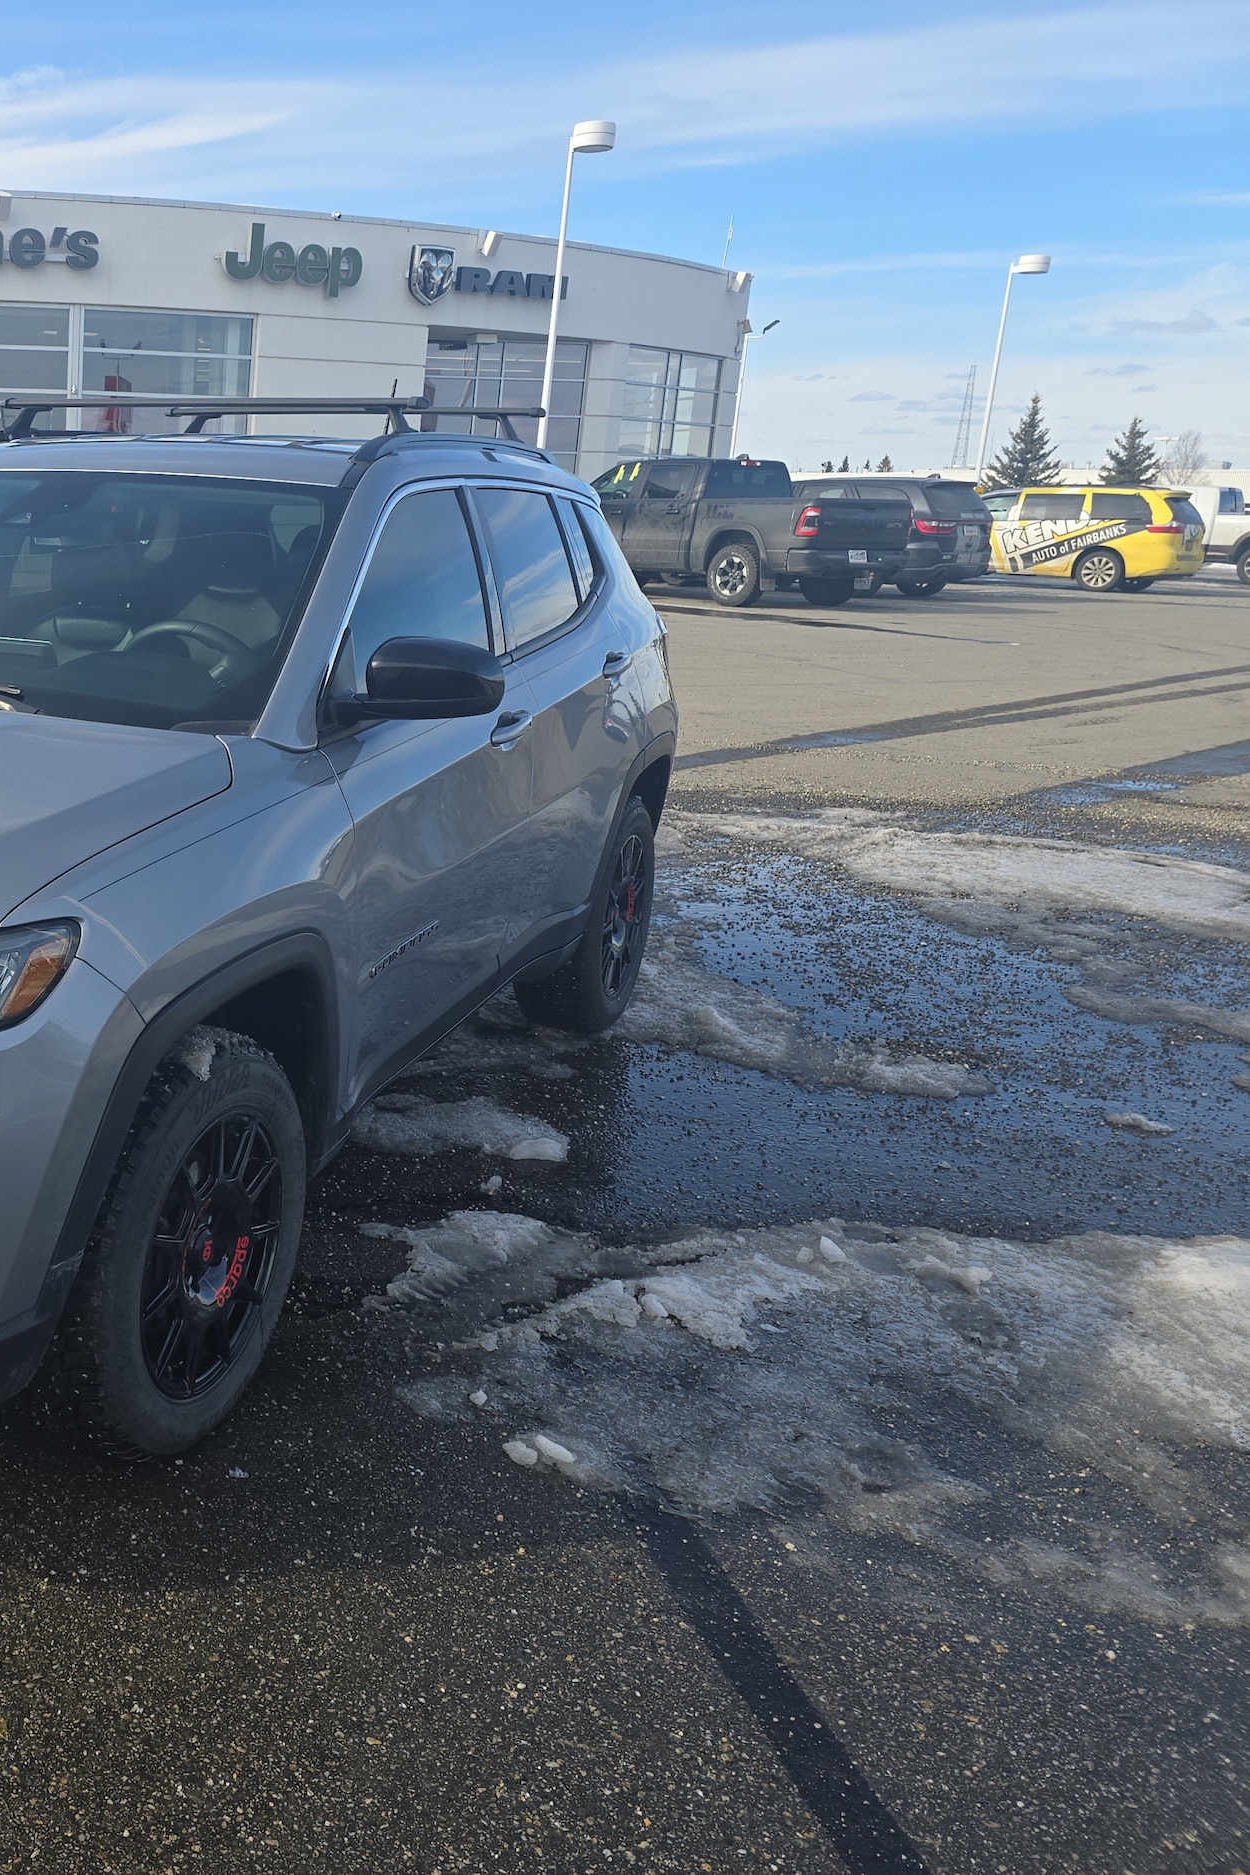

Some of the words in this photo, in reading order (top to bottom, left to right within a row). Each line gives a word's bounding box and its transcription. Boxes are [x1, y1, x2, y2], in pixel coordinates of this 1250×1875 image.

[222, 222, 363, 298] Jeep
[456, 266, 569, 300] RAM
[1031, 546, 1057, 563] AUTO
[1059, 541, 1070, 554] of
[1070, 523, 1127, 551] FAIRBANKS
[214, 1235, 250, 1308] sparco
